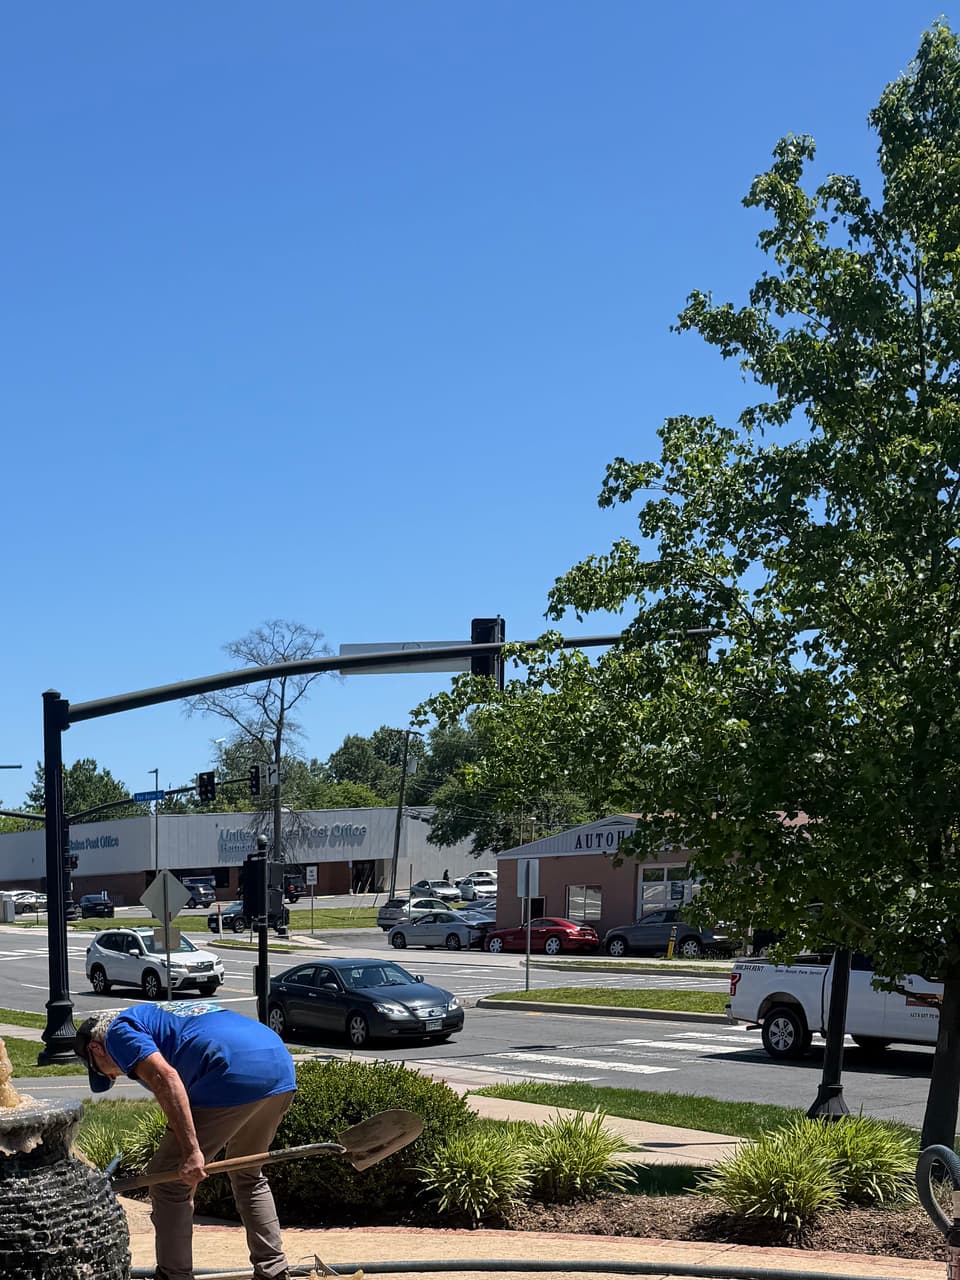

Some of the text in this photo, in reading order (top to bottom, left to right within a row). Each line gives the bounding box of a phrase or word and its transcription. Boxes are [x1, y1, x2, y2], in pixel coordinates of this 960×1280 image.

[331, 822, 367, 838] Office
[86, 837, 100, 850] Post
[100, 835, 120, 849] Office
